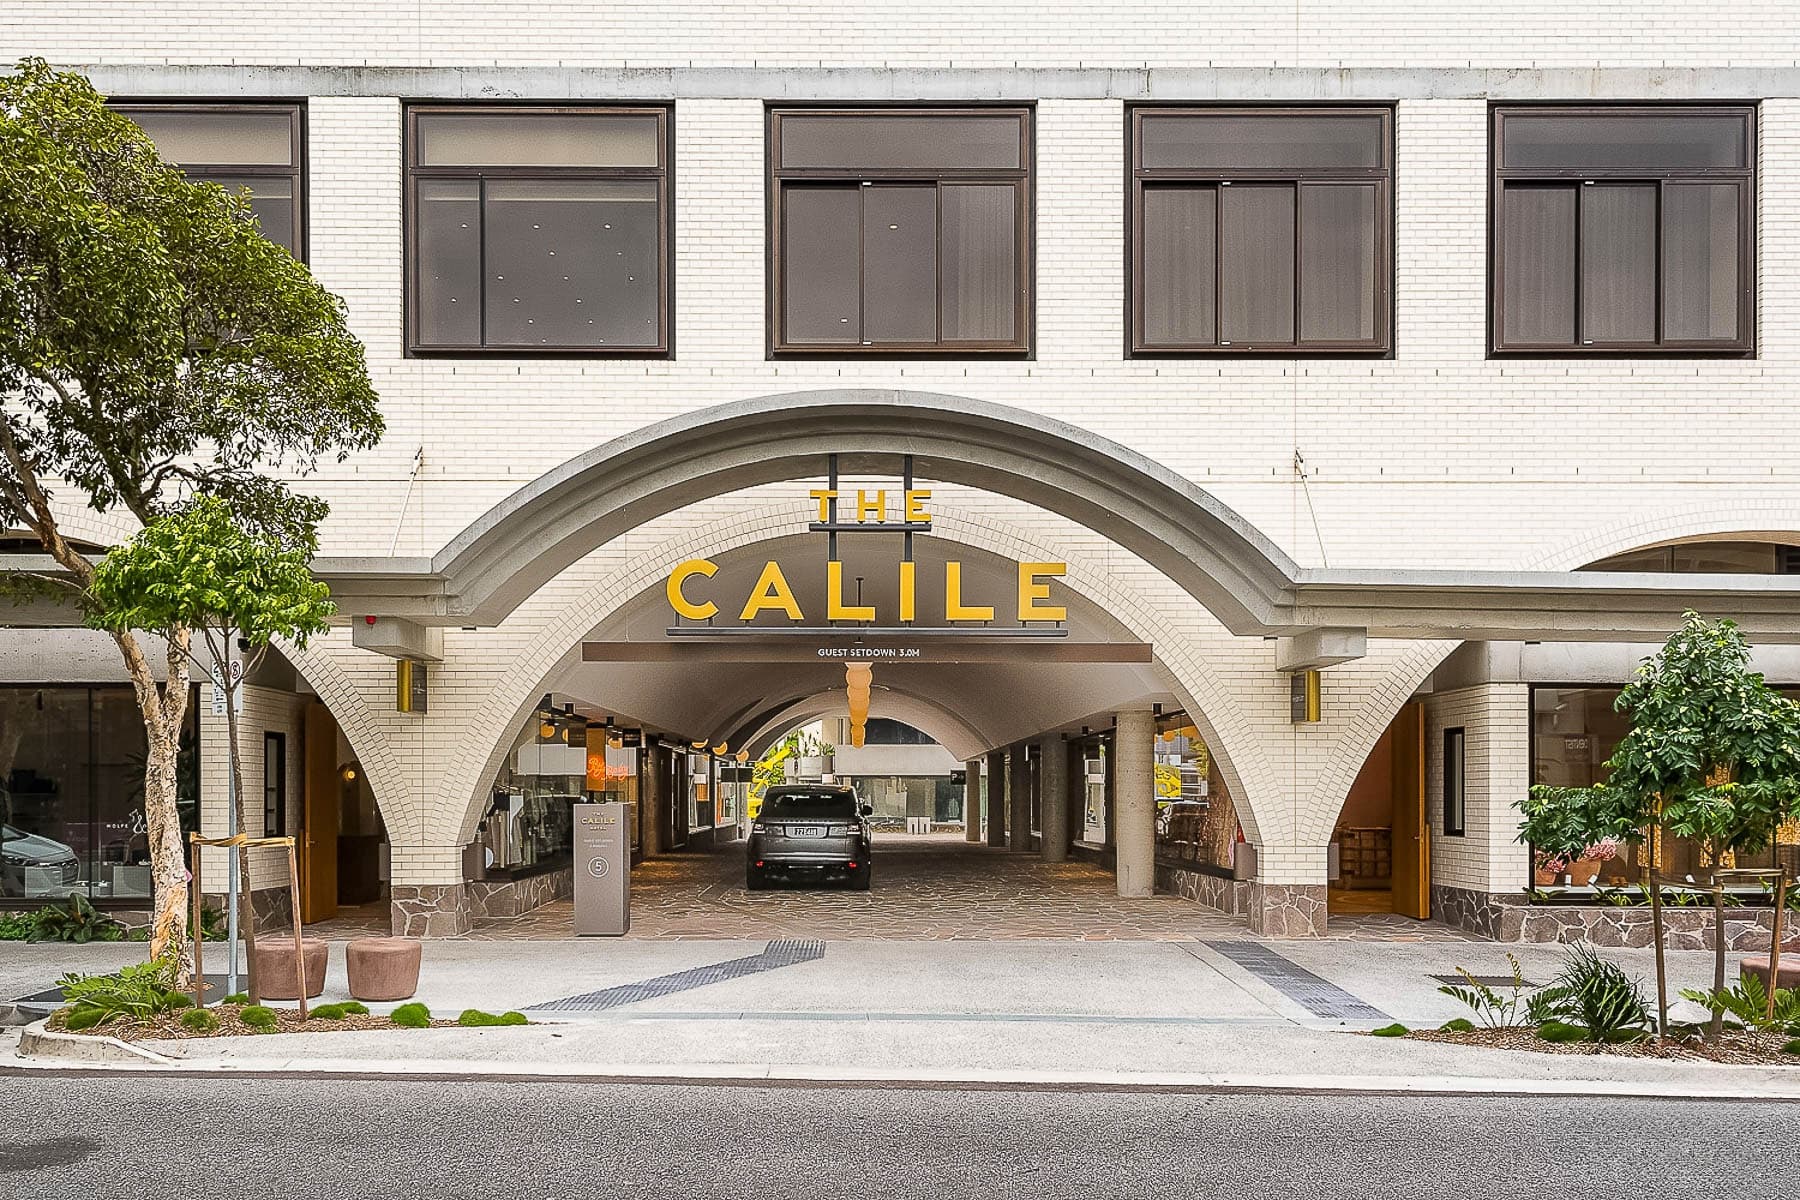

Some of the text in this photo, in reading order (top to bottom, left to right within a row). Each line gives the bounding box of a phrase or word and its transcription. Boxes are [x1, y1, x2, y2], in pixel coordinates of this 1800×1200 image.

[810, 490, 932, 523] THE
[666, 558, 1067, 622] CALILE
[817, 648, 920, 657] GUEST SETDOWN 3.0M
